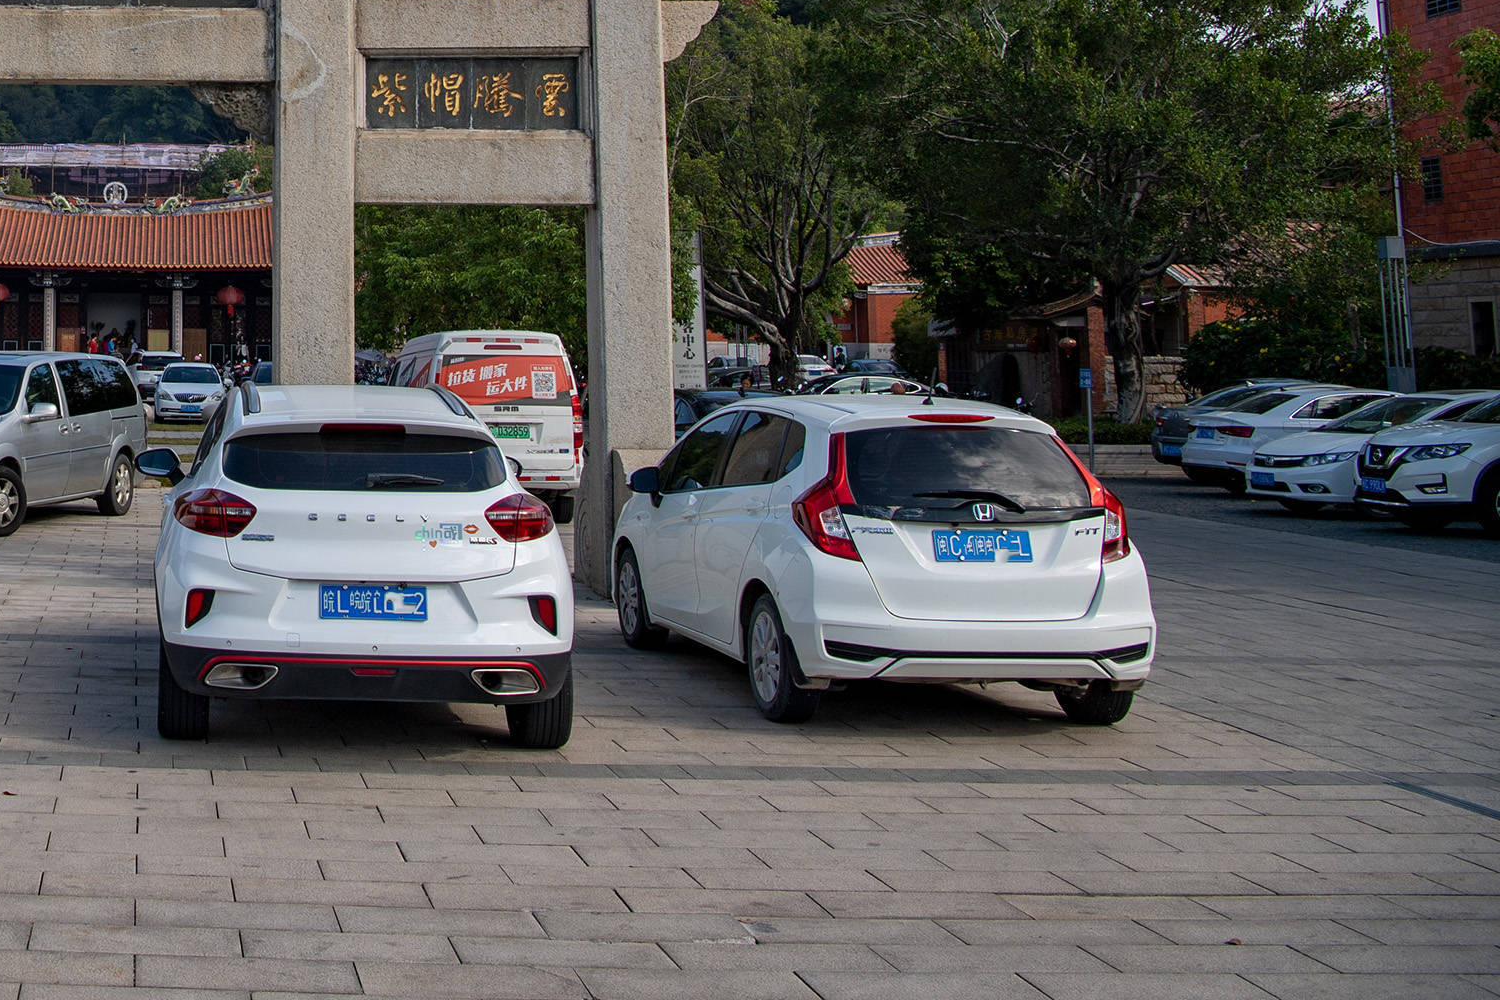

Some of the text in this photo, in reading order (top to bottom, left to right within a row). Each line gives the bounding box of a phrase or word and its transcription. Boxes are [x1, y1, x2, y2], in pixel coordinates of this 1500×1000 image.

[447, 363, 508, 387] 拉货 搬家
[486, 376, 528, 397] 运大件
[1074, 527, 1100, 537] FIT
